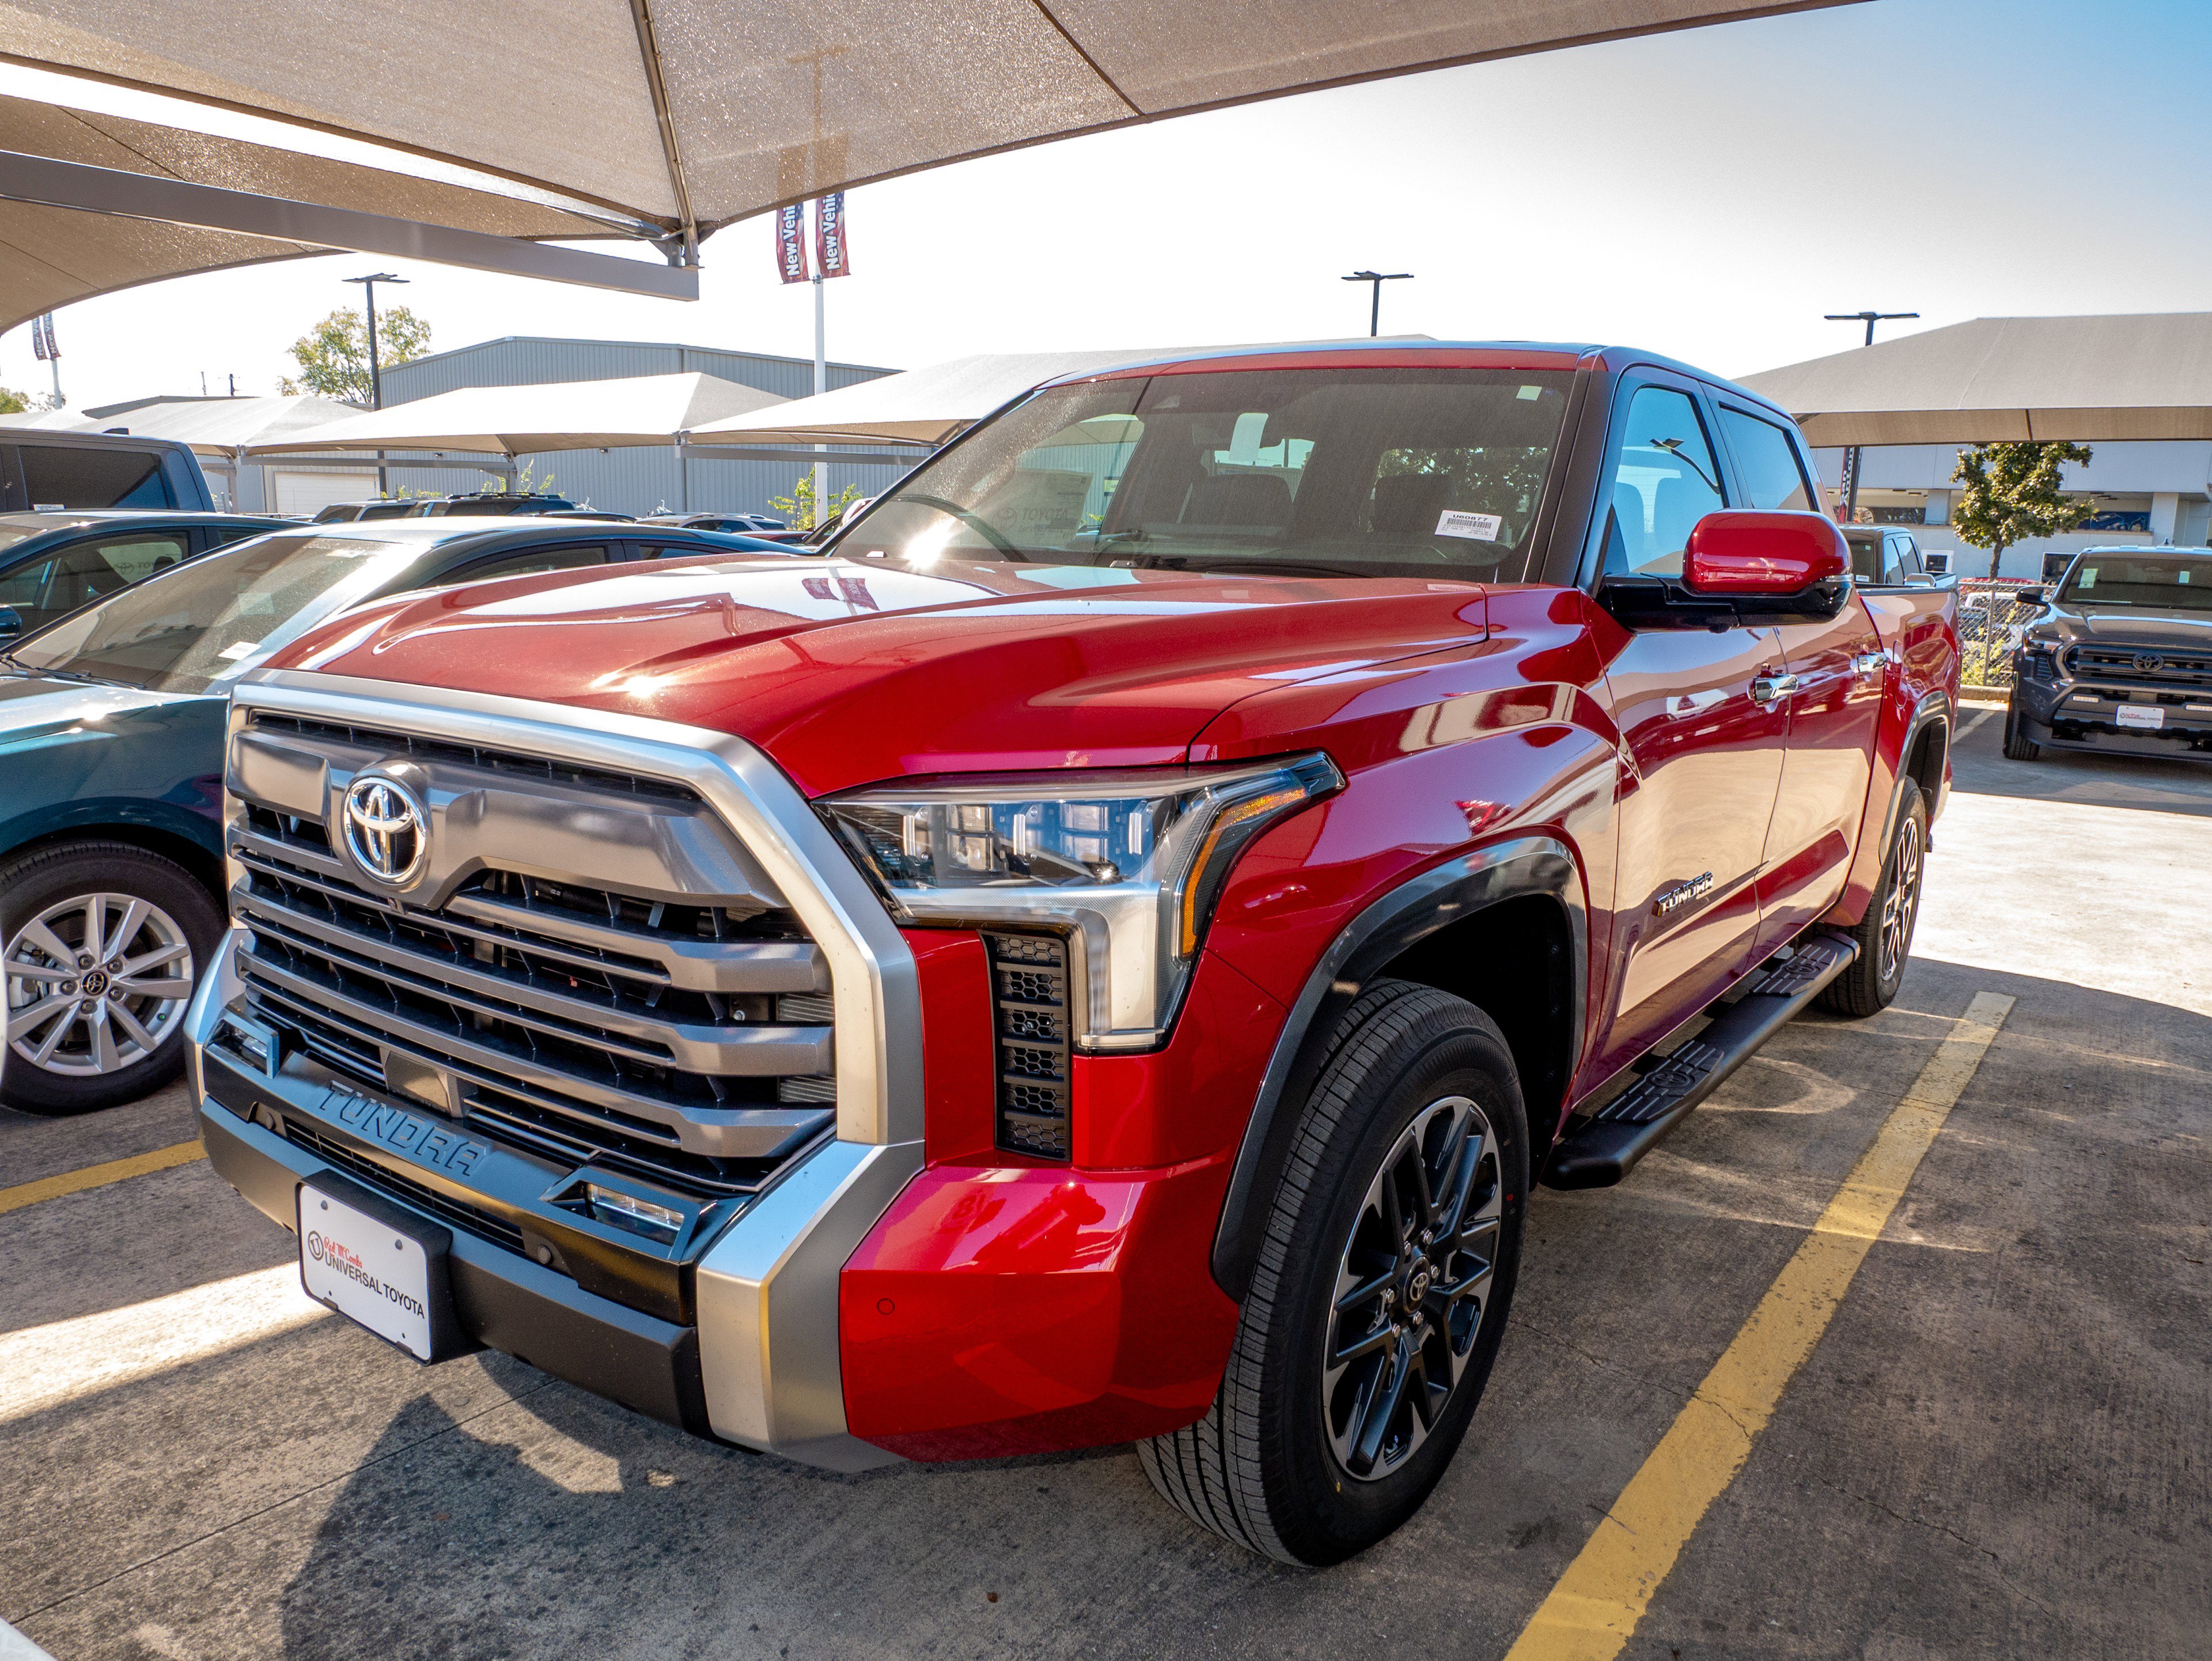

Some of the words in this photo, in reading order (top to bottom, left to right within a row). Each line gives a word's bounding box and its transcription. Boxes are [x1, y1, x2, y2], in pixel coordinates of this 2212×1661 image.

[786, 241, 800, 277] New
[825, 235, 840, 270] New
[1652, 871, 1713, 917] TUNDRA
[320, 1080, 487, 1176] TUNDRA
[325, 1251, 382, 1296] UNIVERSAL
[383, 1283, 425, 1319] TOYOTA
